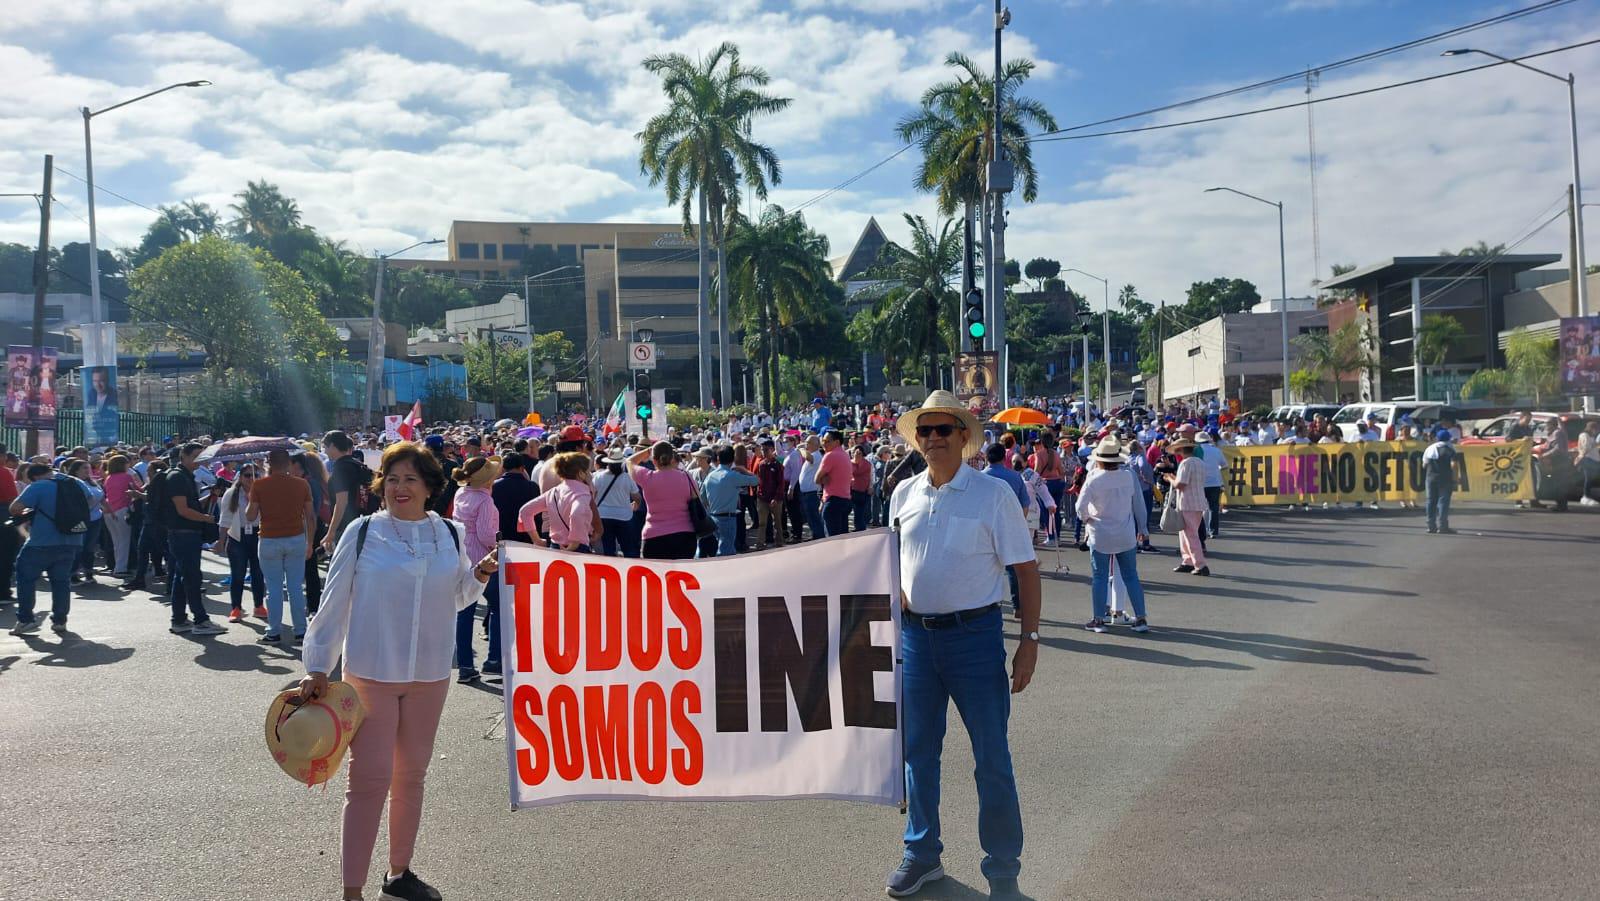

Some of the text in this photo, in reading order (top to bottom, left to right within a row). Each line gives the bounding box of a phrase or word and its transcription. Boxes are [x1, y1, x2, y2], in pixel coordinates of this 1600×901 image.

[1491, 482, 1519, 494] PRD
[505, 559, 702, 675] TODOS
[713, 594, 898, 733] INE
[513, 680, 704, 786] SOMOS
